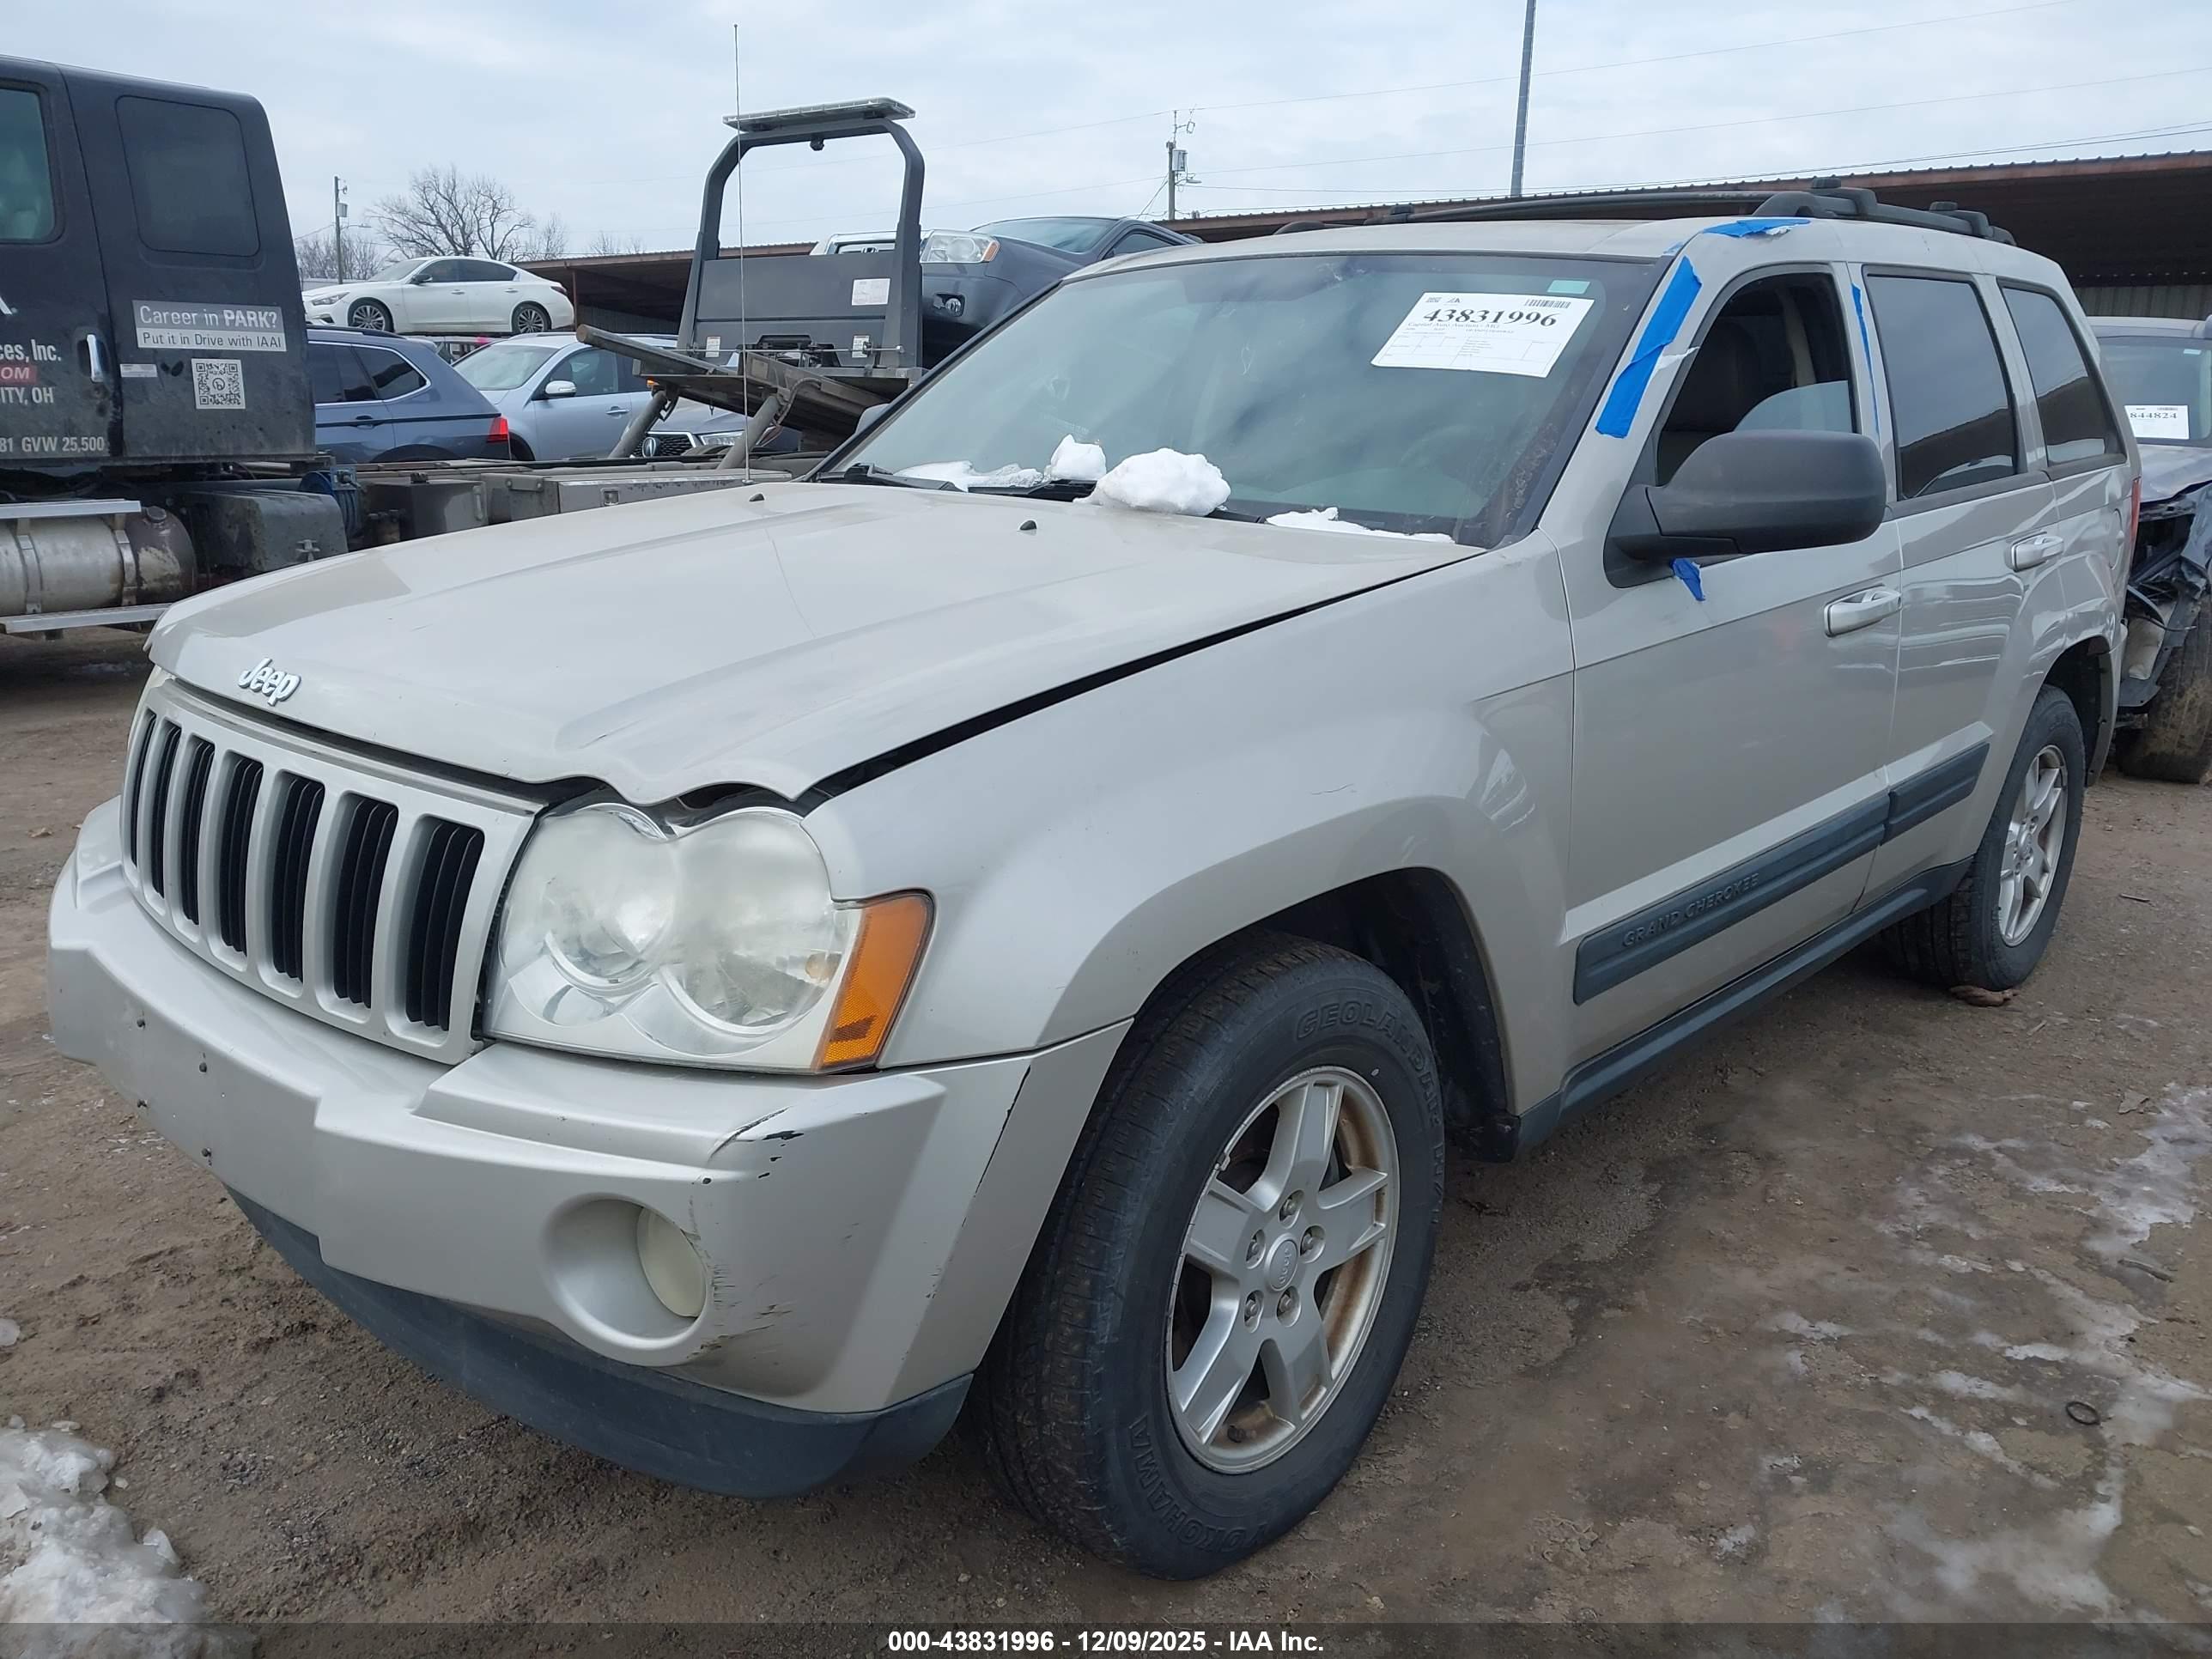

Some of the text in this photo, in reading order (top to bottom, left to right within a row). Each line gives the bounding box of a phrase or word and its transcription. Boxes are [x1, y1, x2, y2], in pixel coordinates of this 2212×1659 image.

[140, 305, 277, 328] Career in PARK?
[1423, 308, 1561, 327] 43831996
[31, 339, 62, 362] Inc.
[143, 332, 282, 348] Put it in Drive with IAAI
[0, 387, 54, 405] ITY, OH
[21, 436, 58, 453] GVW
[62, 436, 105, 453] 25,500
[238, 658, 301, 707] Jeep
[1622, 872, 1759, 947] GRAND CHEROKEE
[1128, 1413, 1268, 1553] YOKOHAMA
